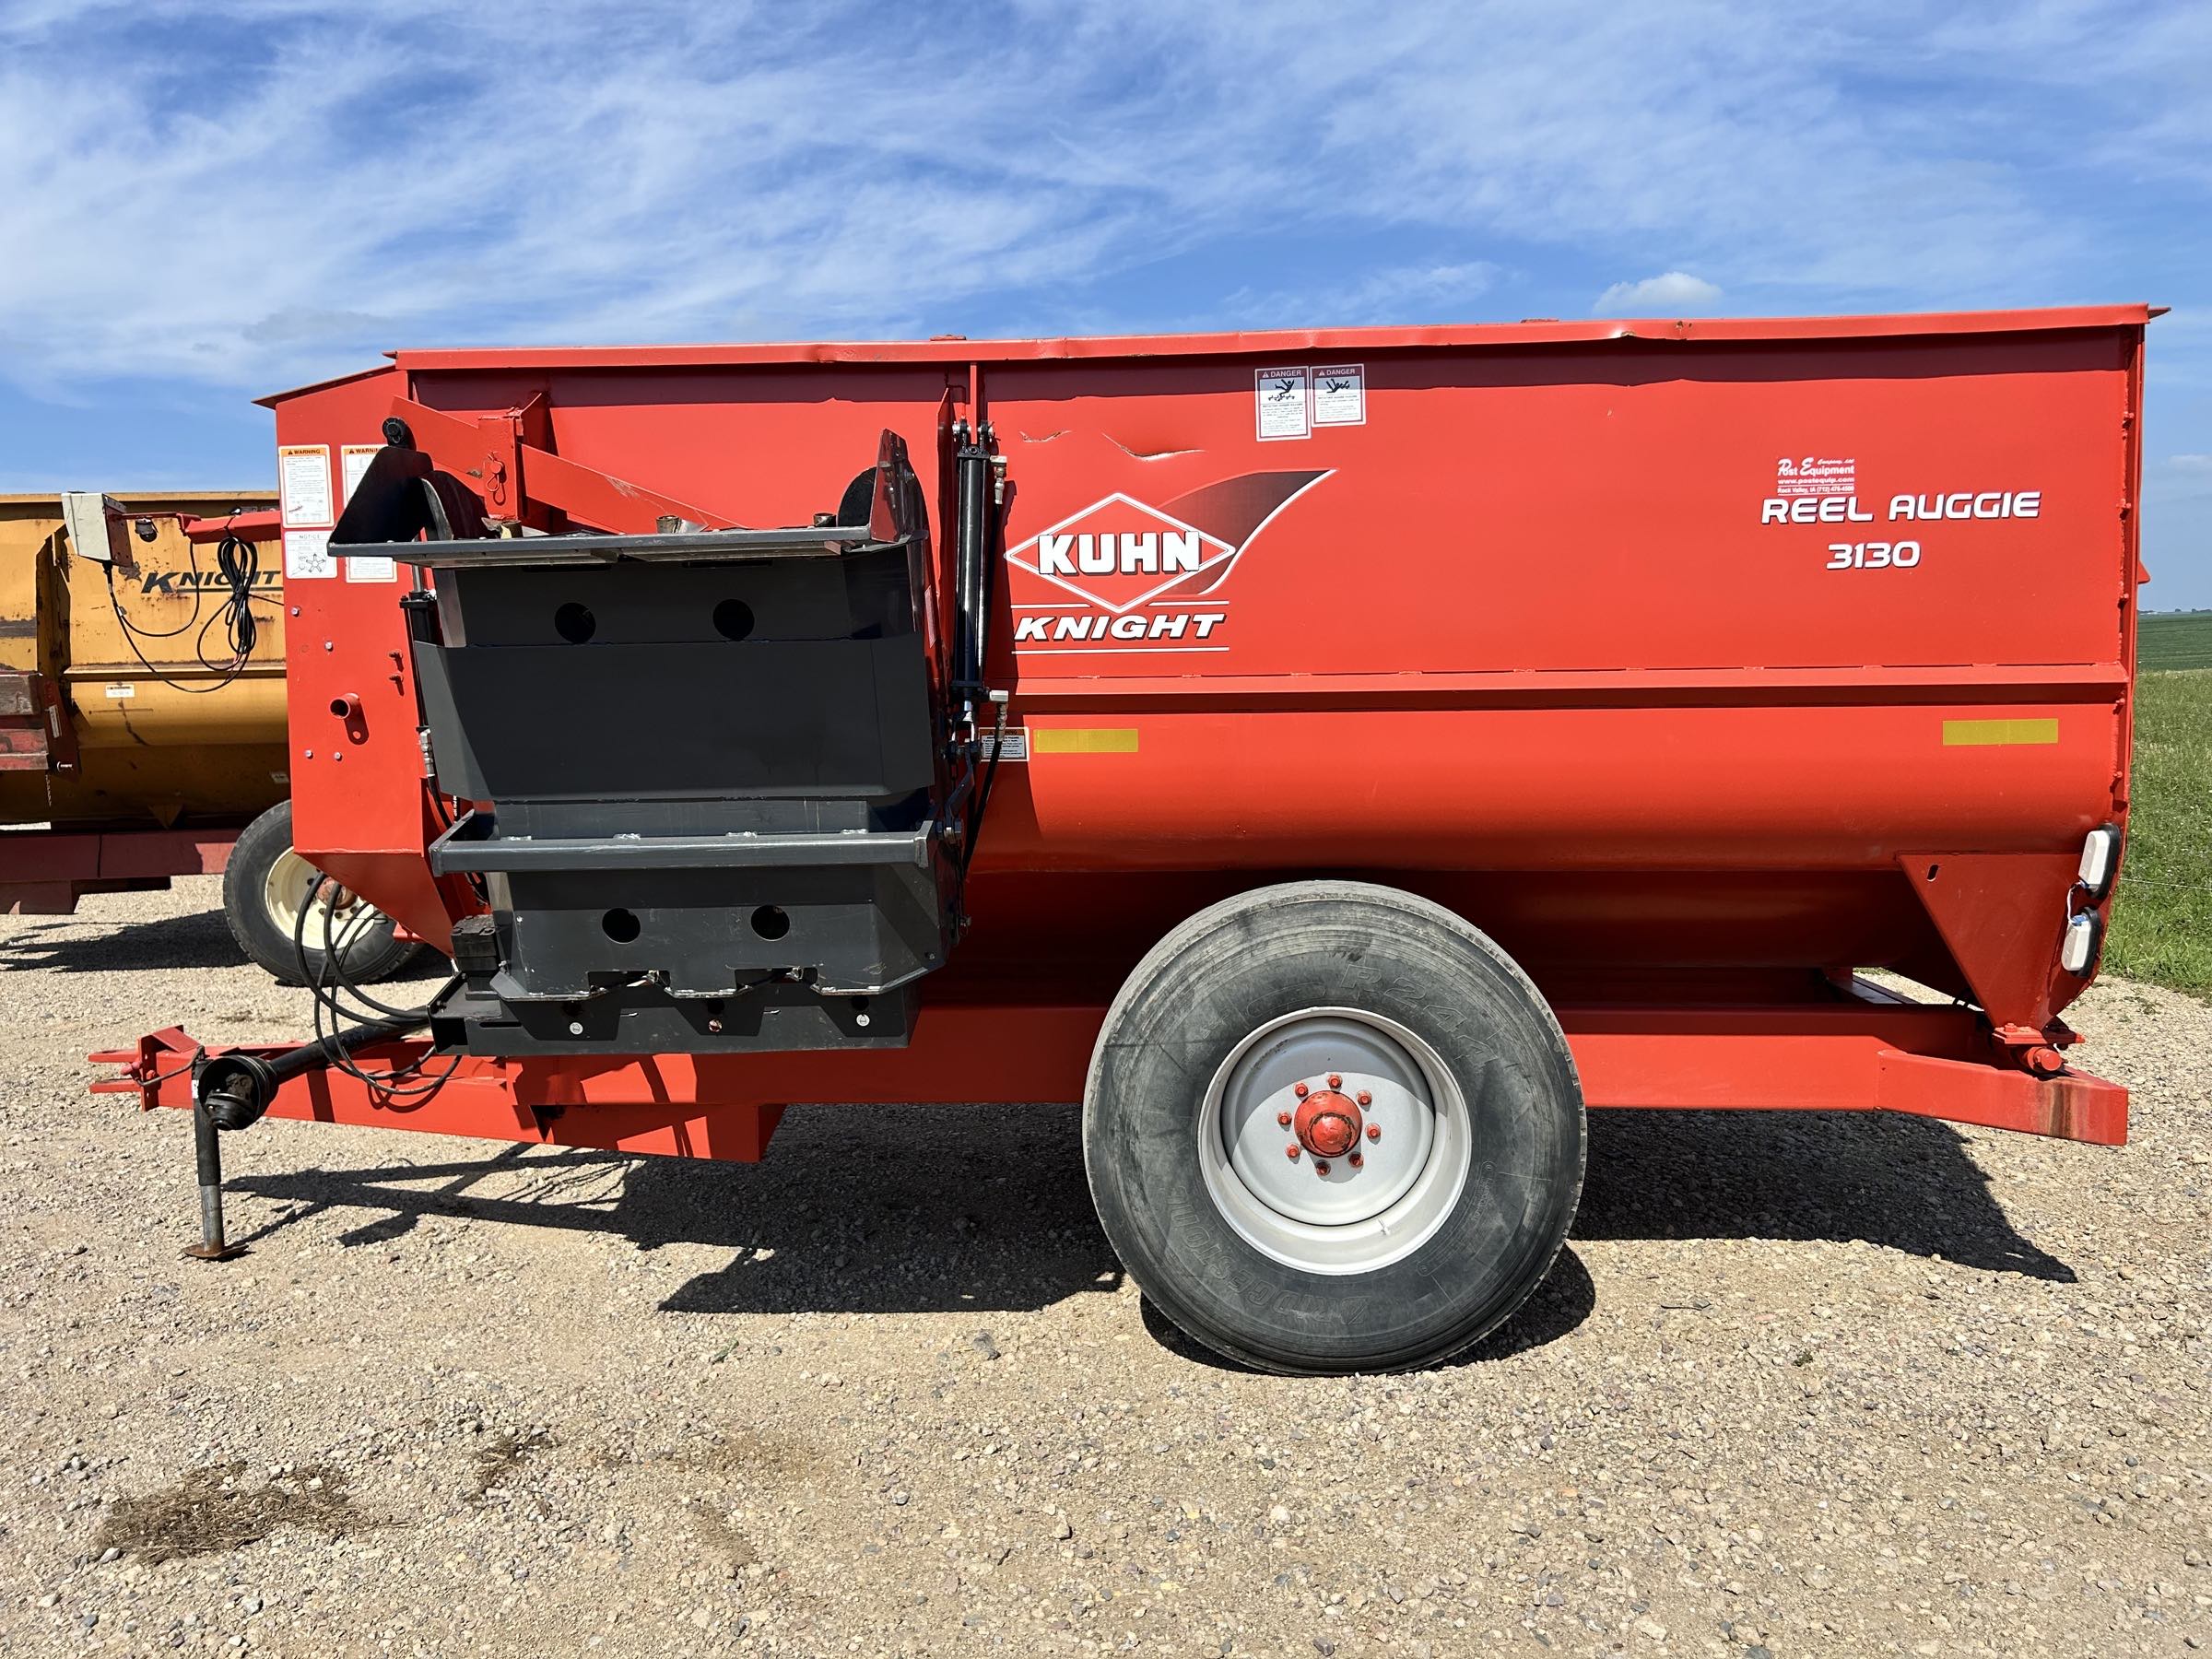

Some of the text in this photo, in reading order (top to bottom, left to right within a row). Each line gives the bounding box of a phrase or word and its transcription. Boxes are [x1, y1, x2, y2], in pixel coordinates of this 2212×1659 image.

[1270, 370, 1302, 378] DANGER
[1325, 368, 1356, 376] DANGER
[1777, 457, 1855, 477] Post Equipment
[1761, 491, 2041, 524] REEL AUGGIE
[1038, 531, 1201, 576] KUHN
[1826, 541, 1921, 570] 3130
[1013, 613, 1228, 642] KNIGHT
